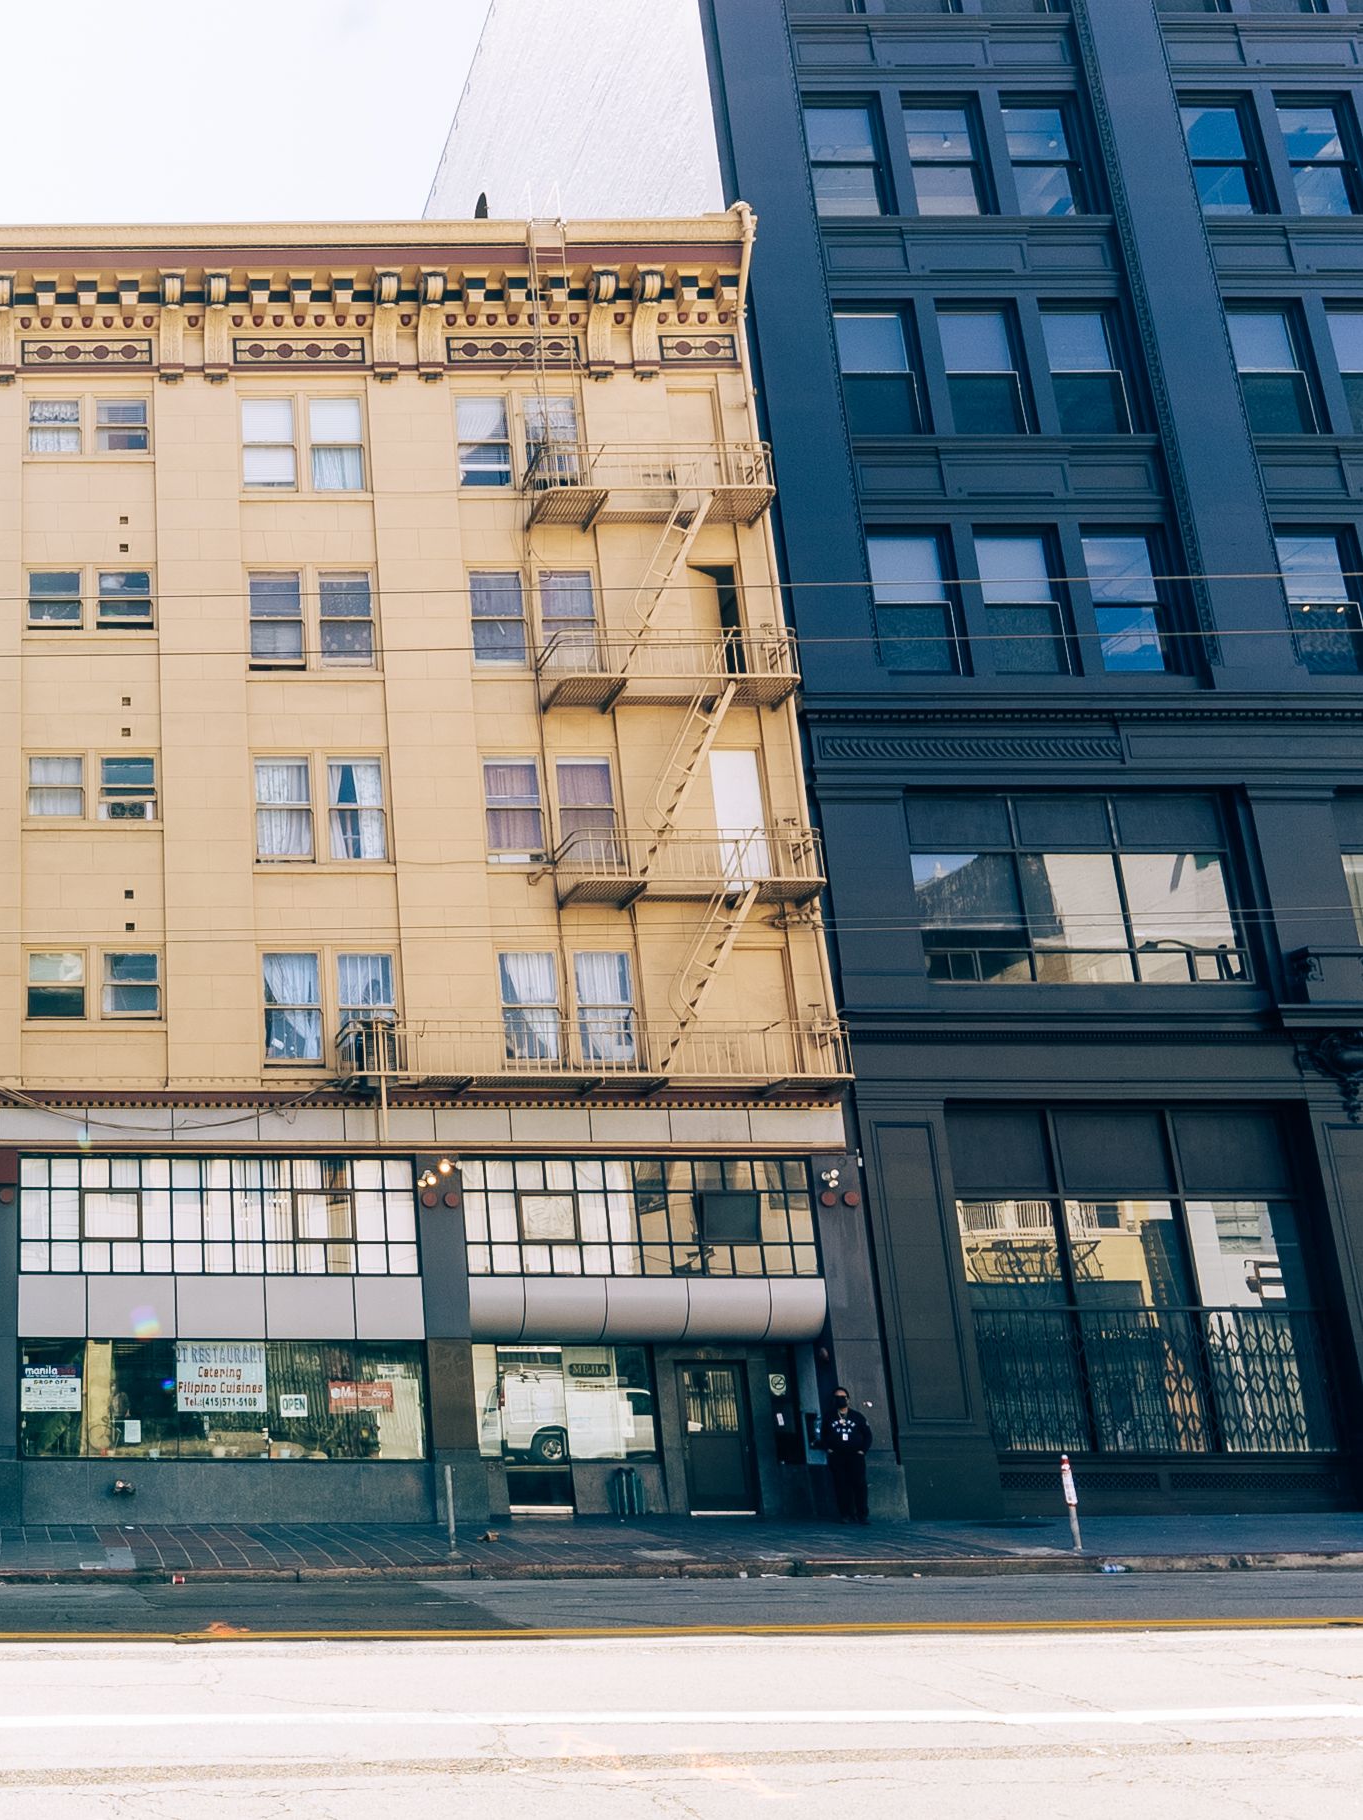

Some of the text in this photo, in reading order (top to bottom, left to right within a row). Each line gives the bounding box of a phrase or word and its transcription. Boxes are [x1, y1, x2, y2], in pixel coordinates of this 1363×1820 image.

[191, 1344, 264, 1364] RESTAURANT
[197, 1366, 242, 1380] Catering
[178, 1381, 263, 1395] Filipino Cuisines
[282, 1397, 306, 1411] OPEN
